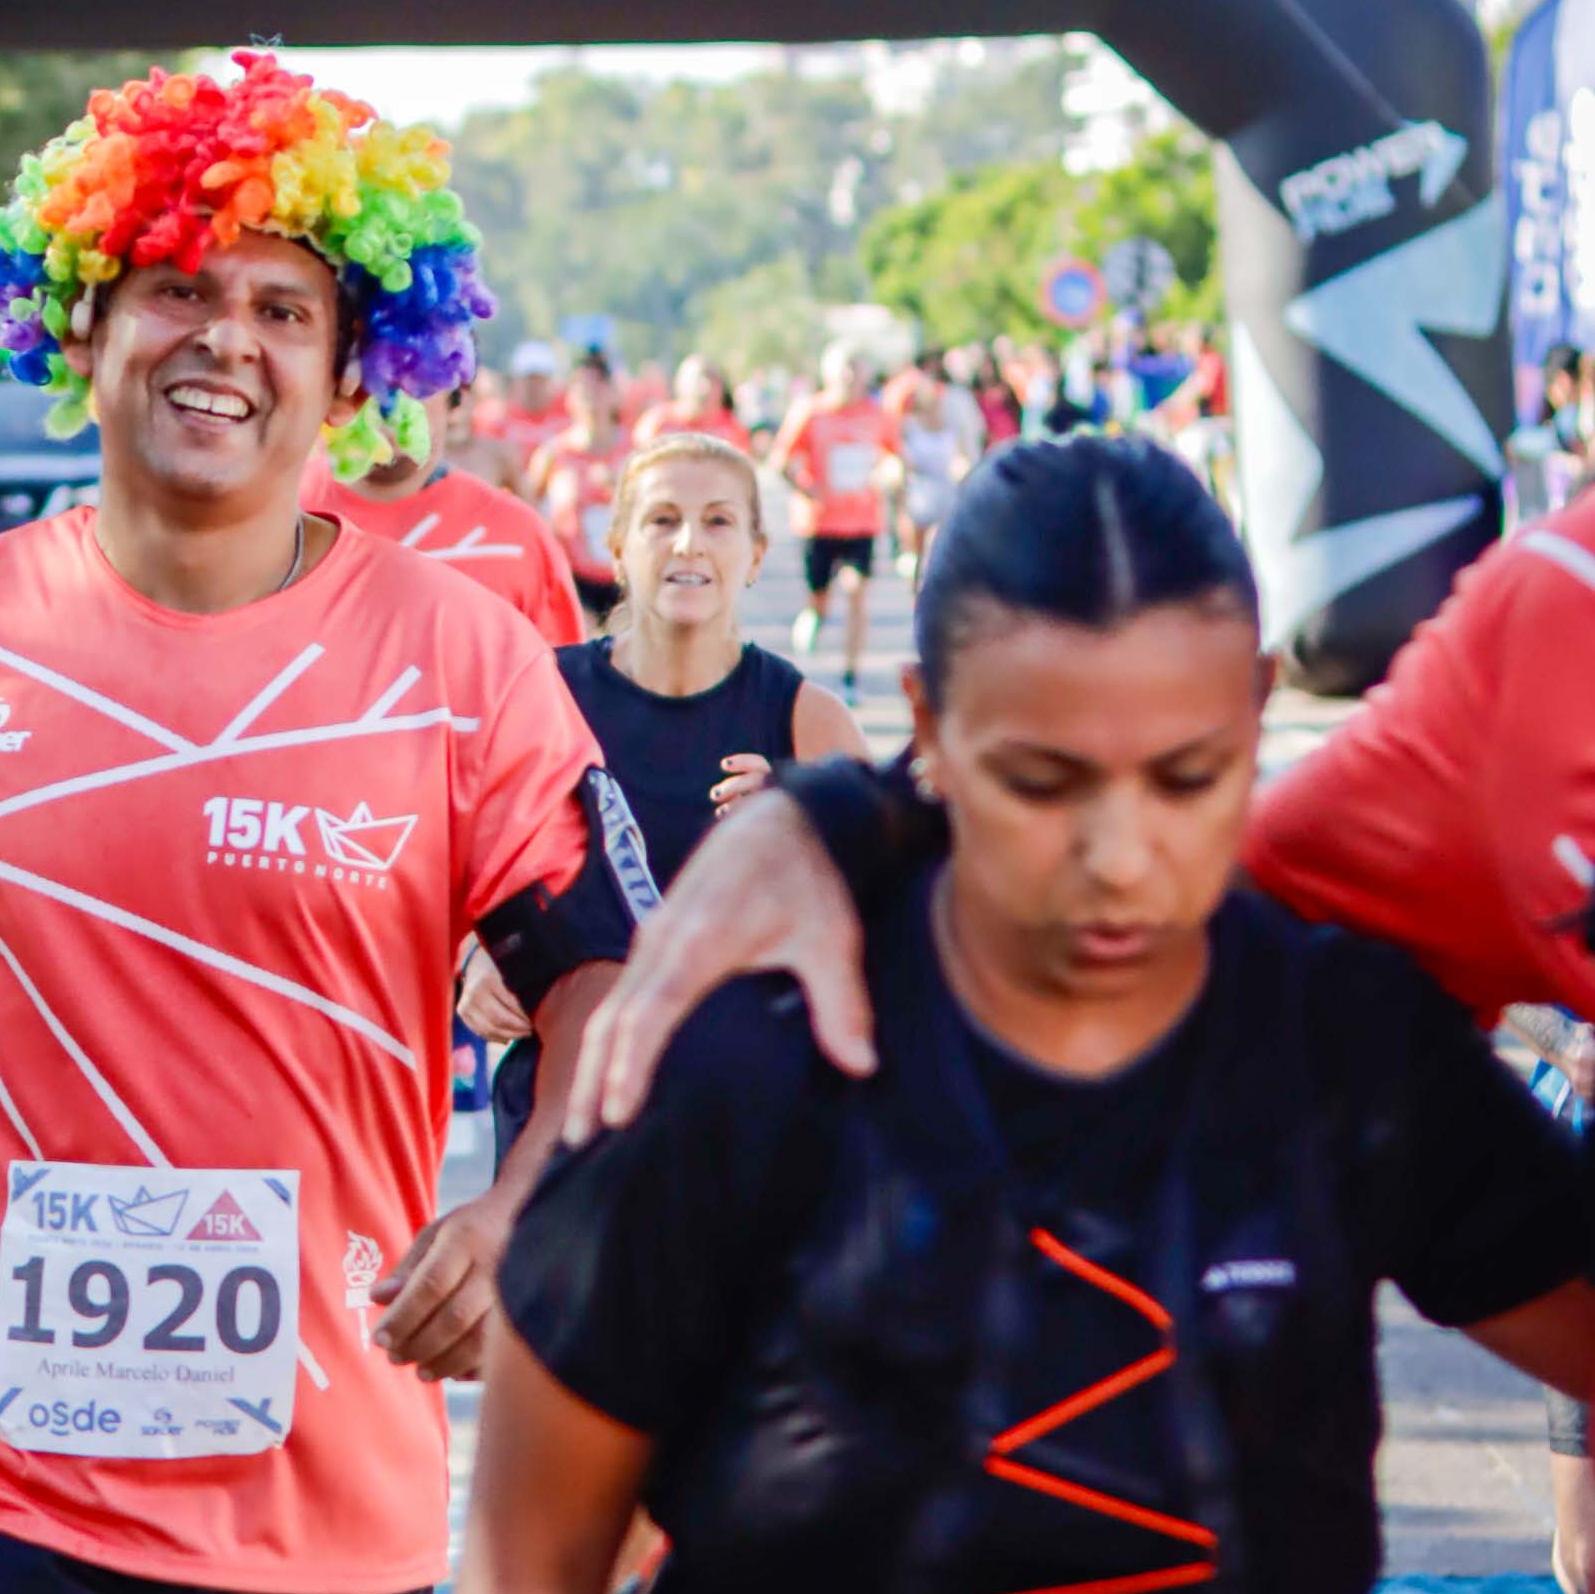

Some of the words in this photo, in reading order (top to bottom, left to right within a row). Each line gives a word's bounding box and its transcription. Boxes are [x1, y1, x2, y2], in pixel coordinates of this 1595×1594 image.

[203, 796, 311, 856] 15K
[207, 851, 305, 874] PUERTO
[314, 864, 388, 890] NORTE
[31, 1190, 100, 1233] 15K
[204, 1213, 247, 1236] 15K
[6, 1257, 281, 1355] 1920
[37, 1358, 89, 1379] Aprile
[96, 1361, 169, 1380] Marcelo
[176, 1364, 235, 1383] Daniel
